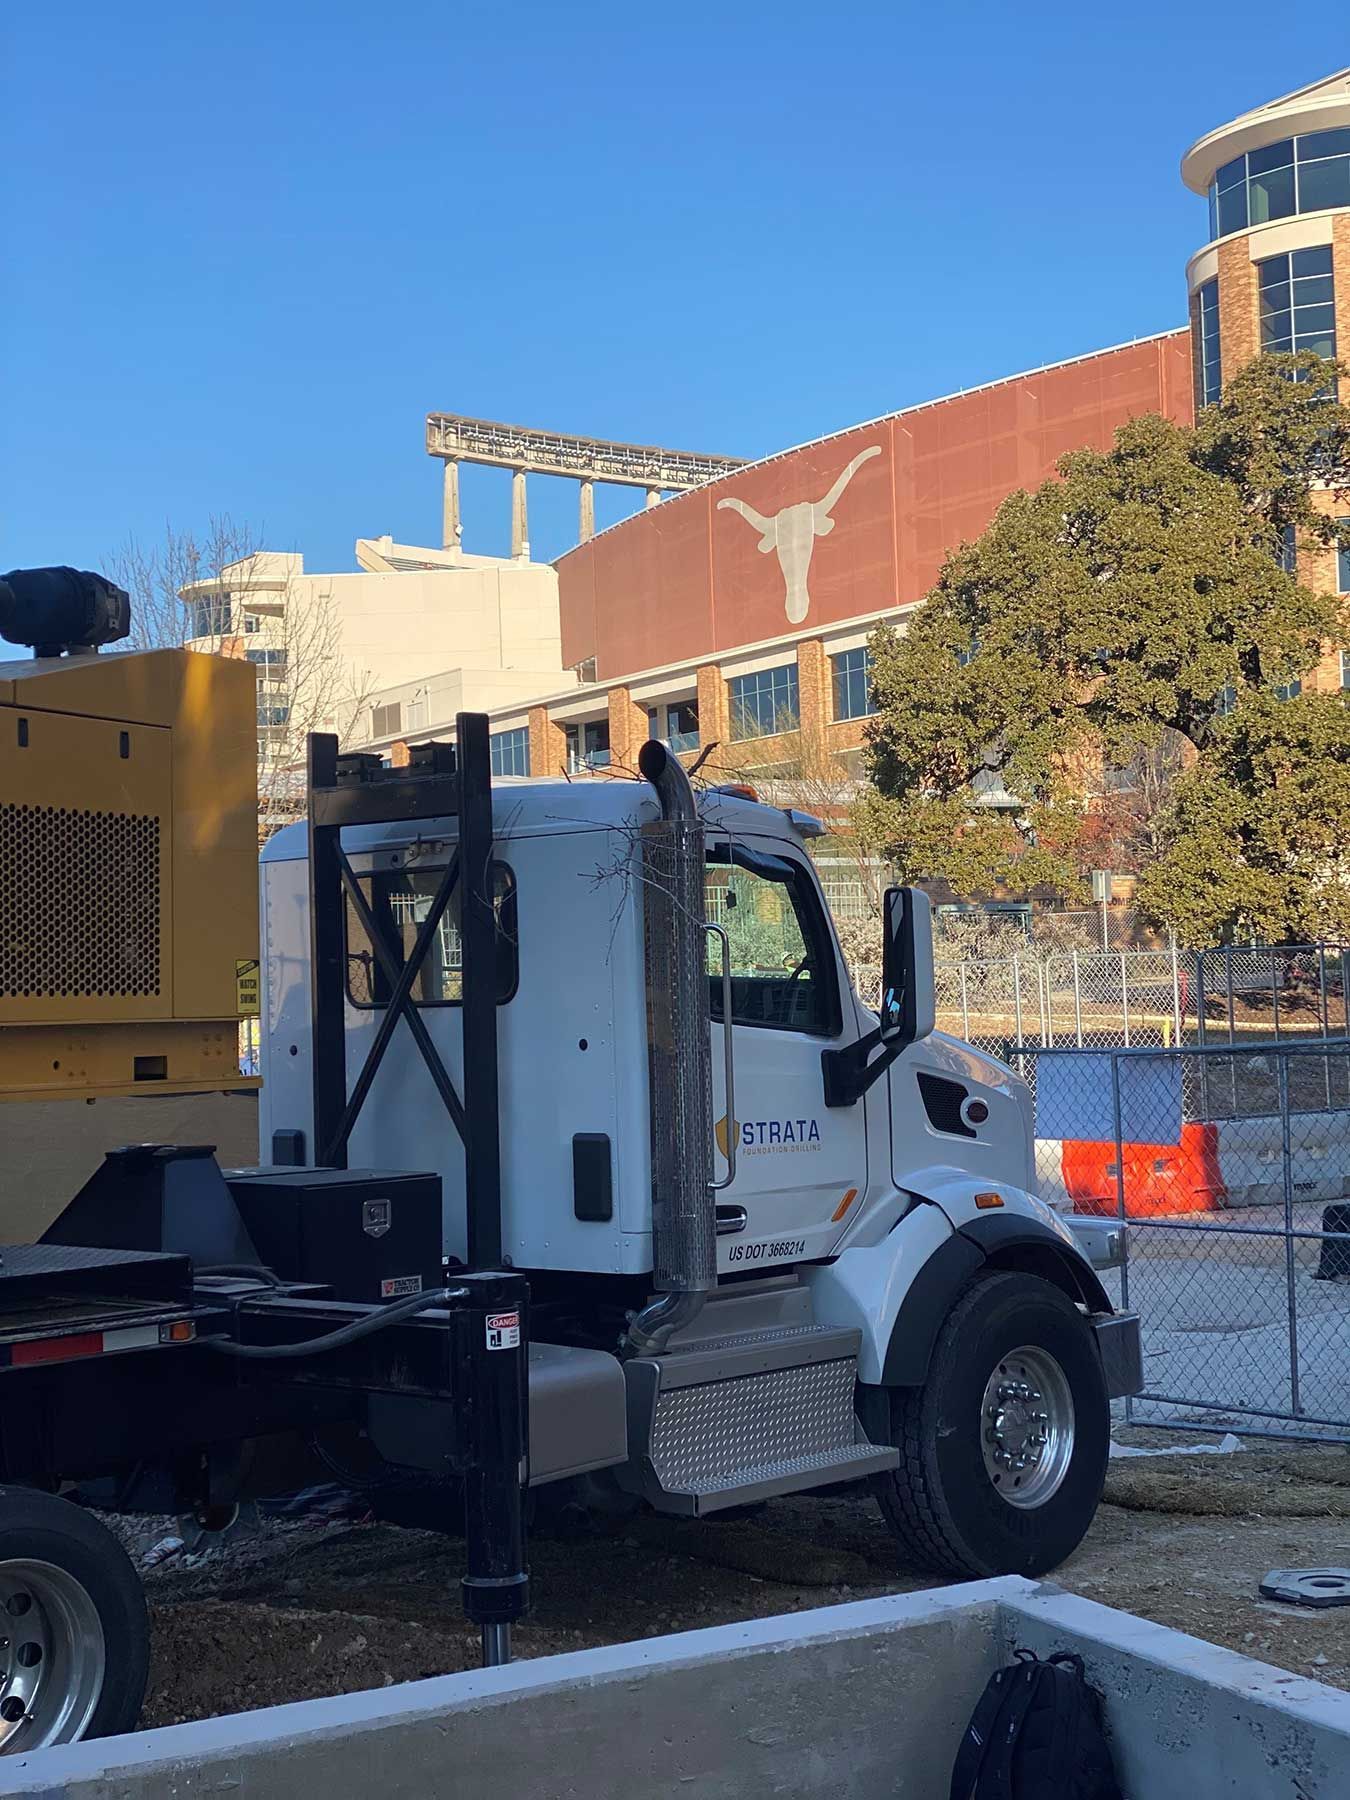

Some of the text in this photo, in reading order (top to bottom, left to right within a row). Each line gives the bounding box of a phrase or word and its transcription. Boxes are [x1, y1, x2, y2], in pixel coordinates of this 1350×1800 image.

[742, 1119, 820, 1145] STRATA
[743, 1143, 822, 1156] FOUNDATION DRILLING
[729, 1240, 806, 1261] US DOT 3668214
